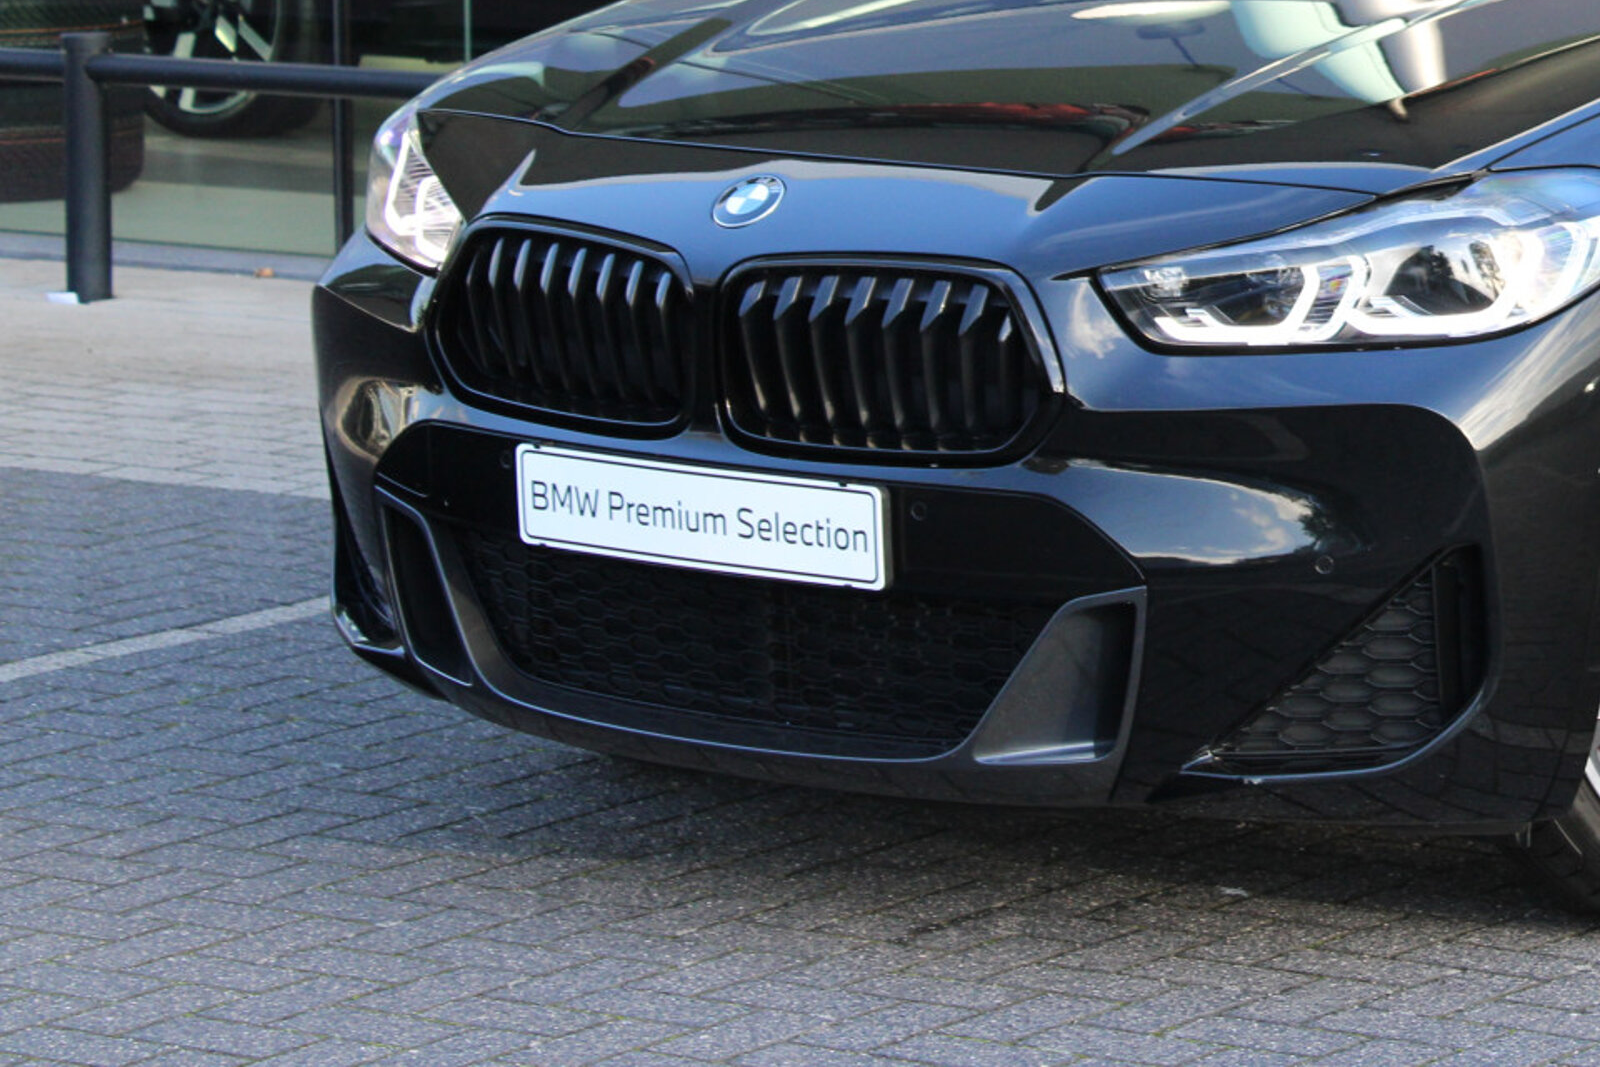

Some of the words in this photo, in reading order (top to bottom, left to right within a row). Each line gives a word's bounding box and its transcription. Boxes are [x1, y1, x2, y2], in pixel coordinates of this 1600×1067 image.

[531, 480, 600, 518] BMW
[608, 490, 728, 536] Premium
[737, 507, 869, 553] Selection
